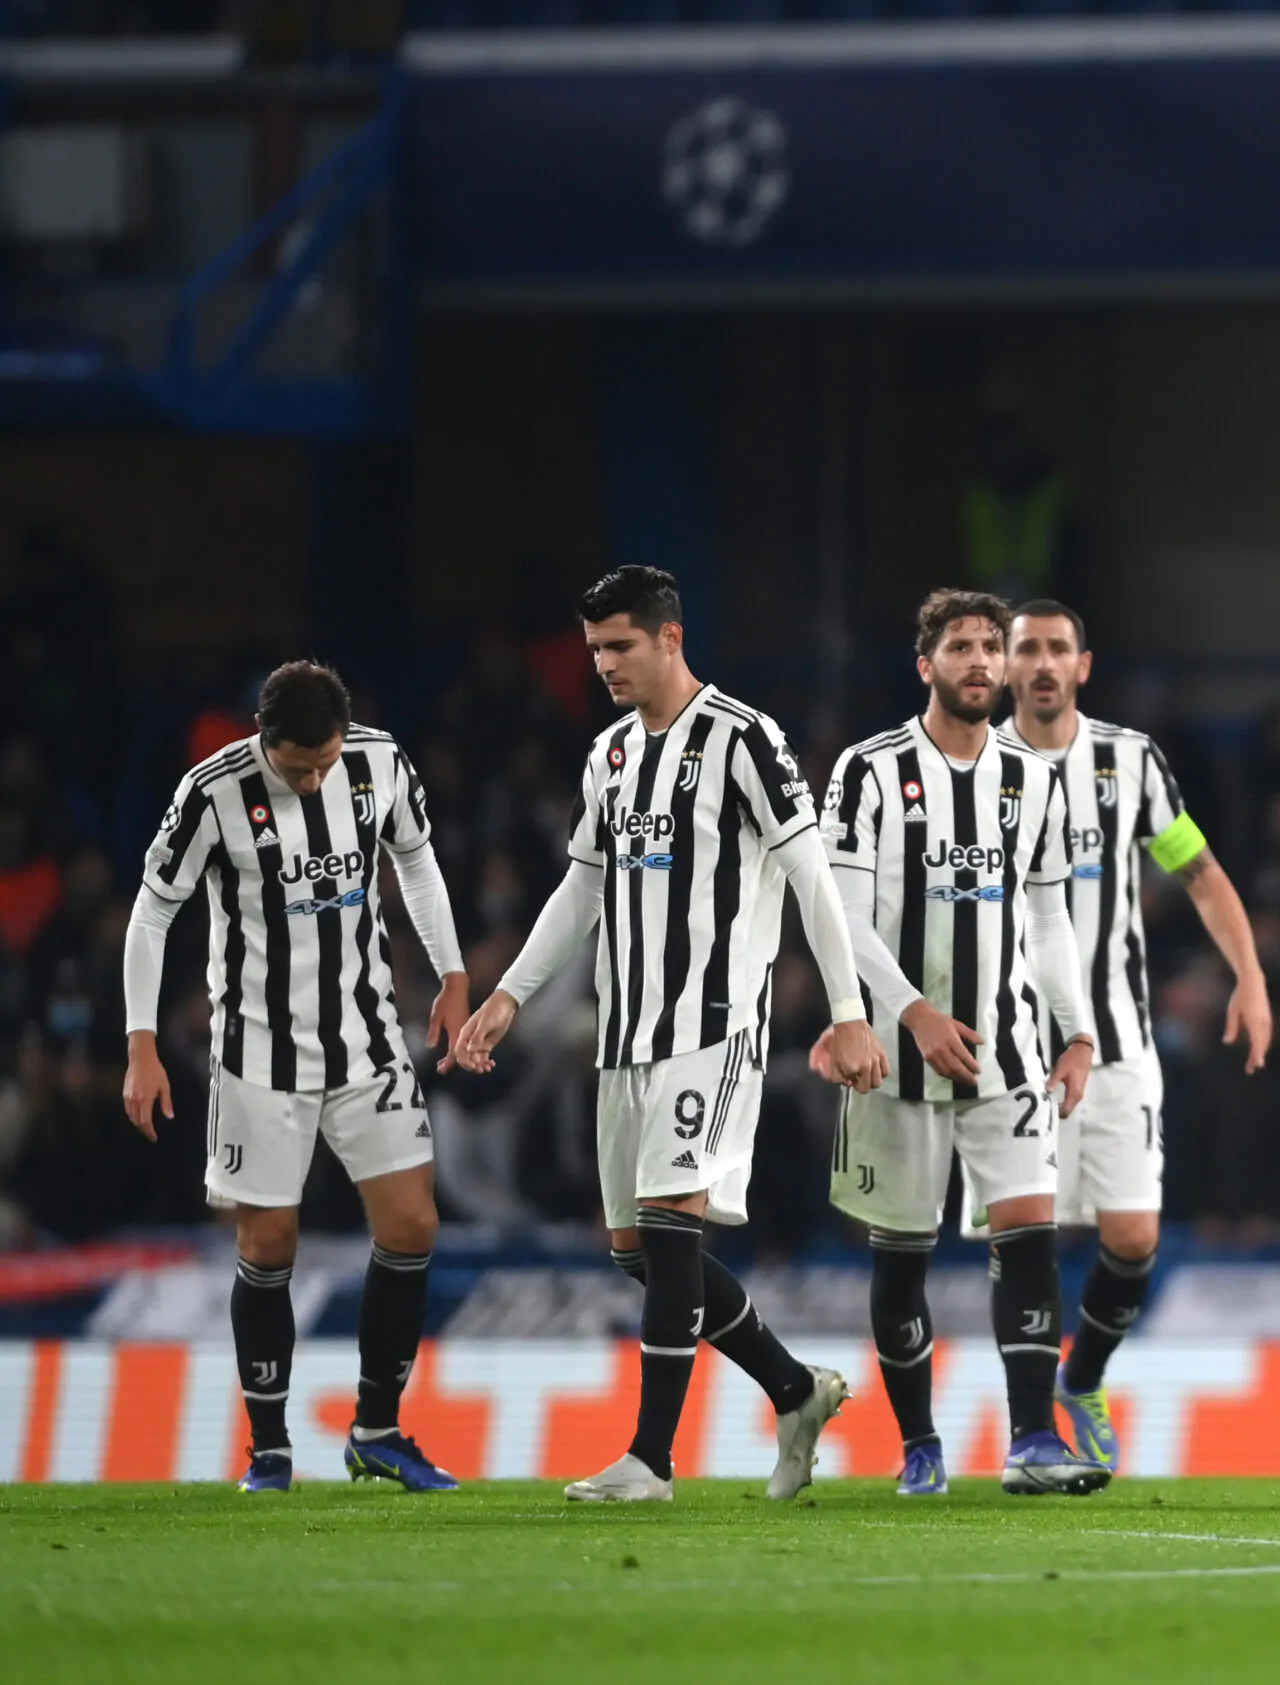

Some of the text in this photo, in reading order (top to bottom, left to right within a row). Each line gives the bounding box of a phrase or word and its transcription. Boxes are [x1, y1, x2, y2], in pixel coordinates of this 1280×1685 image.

[612, 805, 674, 842] Jeep
[279, 850, 363, 885] Jeep
[924, 838, 1005, 874] Jeep
[674, 1089, 705, 1139] 9
